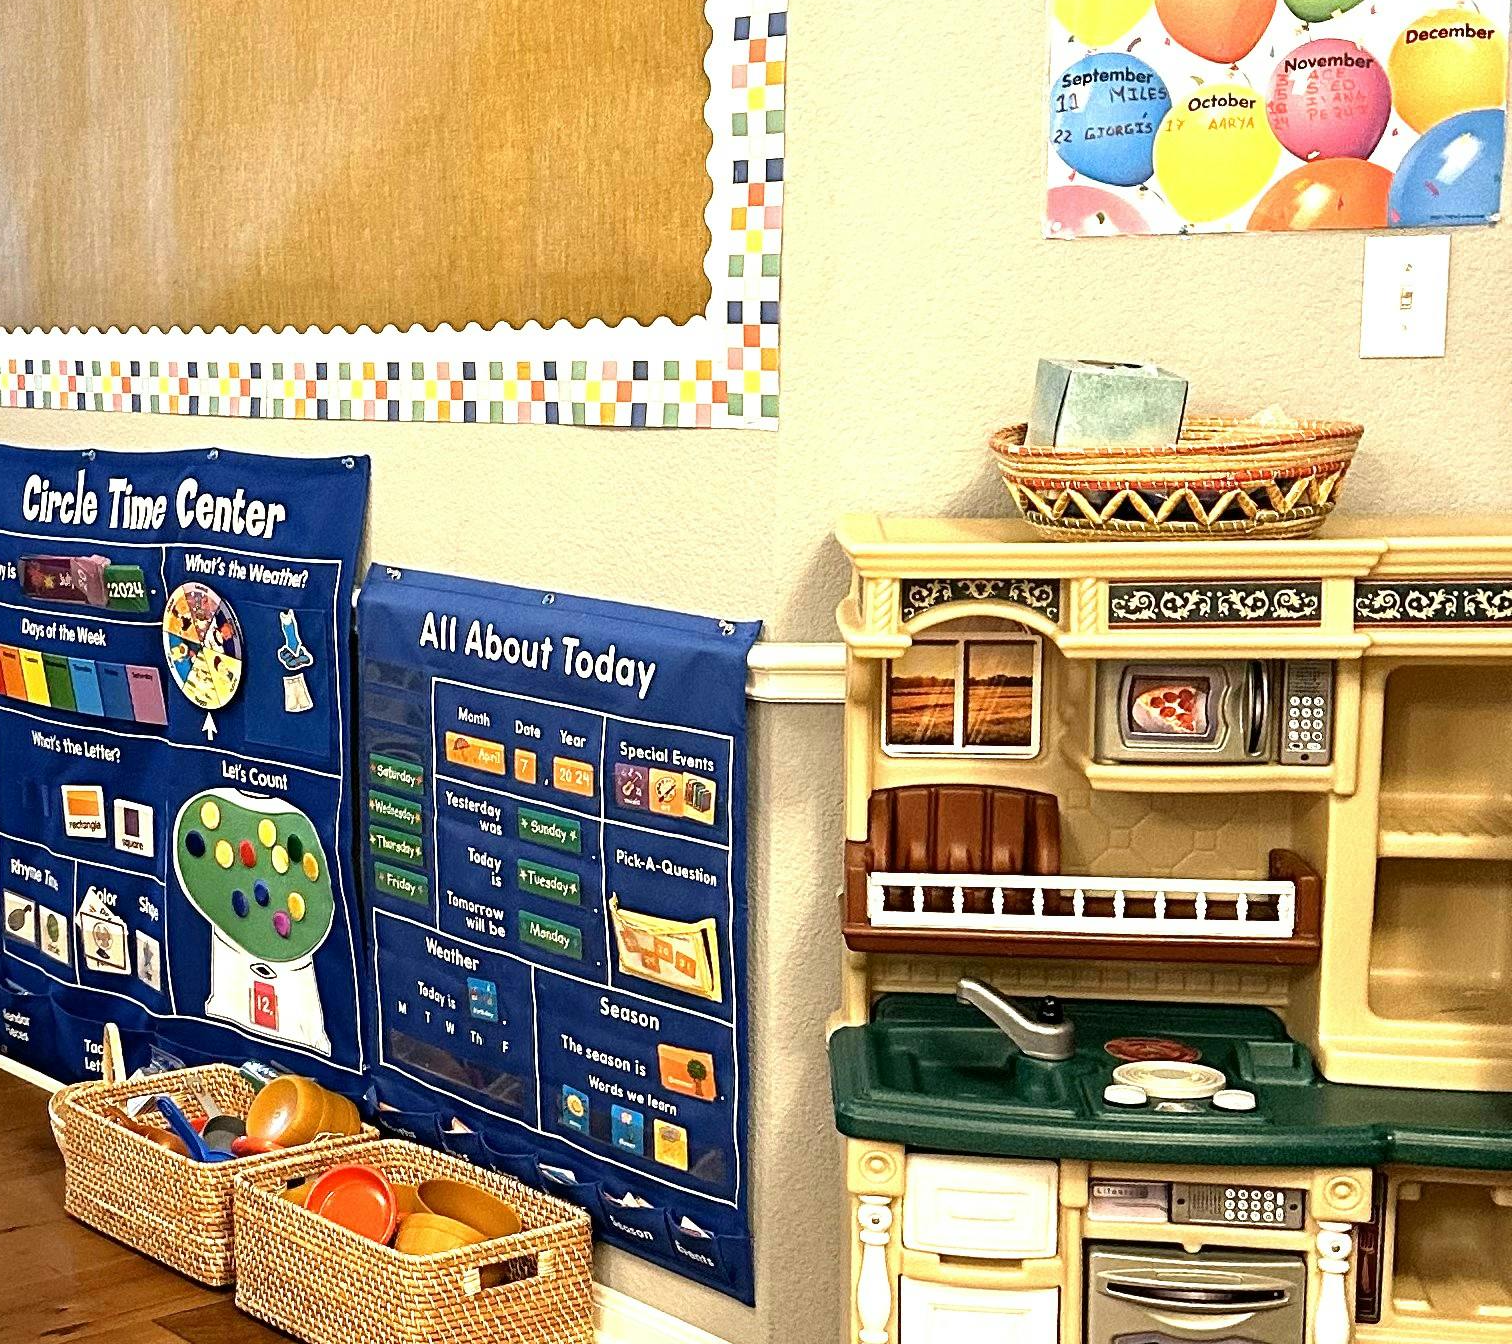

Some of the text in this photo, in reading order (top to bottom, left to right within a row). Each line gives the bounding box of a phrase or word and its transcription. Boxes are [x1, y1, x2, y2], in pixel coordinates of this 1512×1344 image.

[1405, 23, 1495, 44] December
[1284, 52, 1374, 73] November
[1062, 67, 1153, 88] September
[1109, 86, 1166, 103] MILES
[1188, 93, 1256, 111] October
[1053, 129, 1073, 144] 22
[23, 470, 286, 539] Circle Time Center
[7, 561, 17, 580] is
[185, 553, 309, 589] What's the Weather?
[21, 618, 107, 646] Days of the Week
[419, 611, 657, 700] All About Today
[458, 706, 491, 727] Month
[514, 720, 541, 739] Date
[31, 730, 121, 764] What's the Letter?
[559, 729, 587, 748] Year
[620, 741, 715, 772] Special Events
[221, 759, 288, 791] Let's Count
[376, 765, 416, 786] Saturday
[374, 799, 416, 824] Wednesday
[445, 790, 502, 820] Yesterday
[479, 819, 567, 843] was Sunday
[376, 834, 415, 858] Thursday
[10, 858, 42, 883] Rhyme
[467, 847, 502, 873] Today
[616, 848, 718, 887] Pick-A-Question
[386, 872, 416, 895] Friday
[491, 870, 570, 895] is Tuesday
[446, 890, 504, 921] Tomorrow
[466, 915, 571, 949] will be Monday
[425, 936, 480, 971] Weather
[417, 980, 456, 1010] Today is
[398, 1000, 510, 1053] M T W Th F
[599, 996, 661, 1031] Season
[560, 1033, 646, 1077] The season is
[588, 1074, 678, 1116] Words we learn
